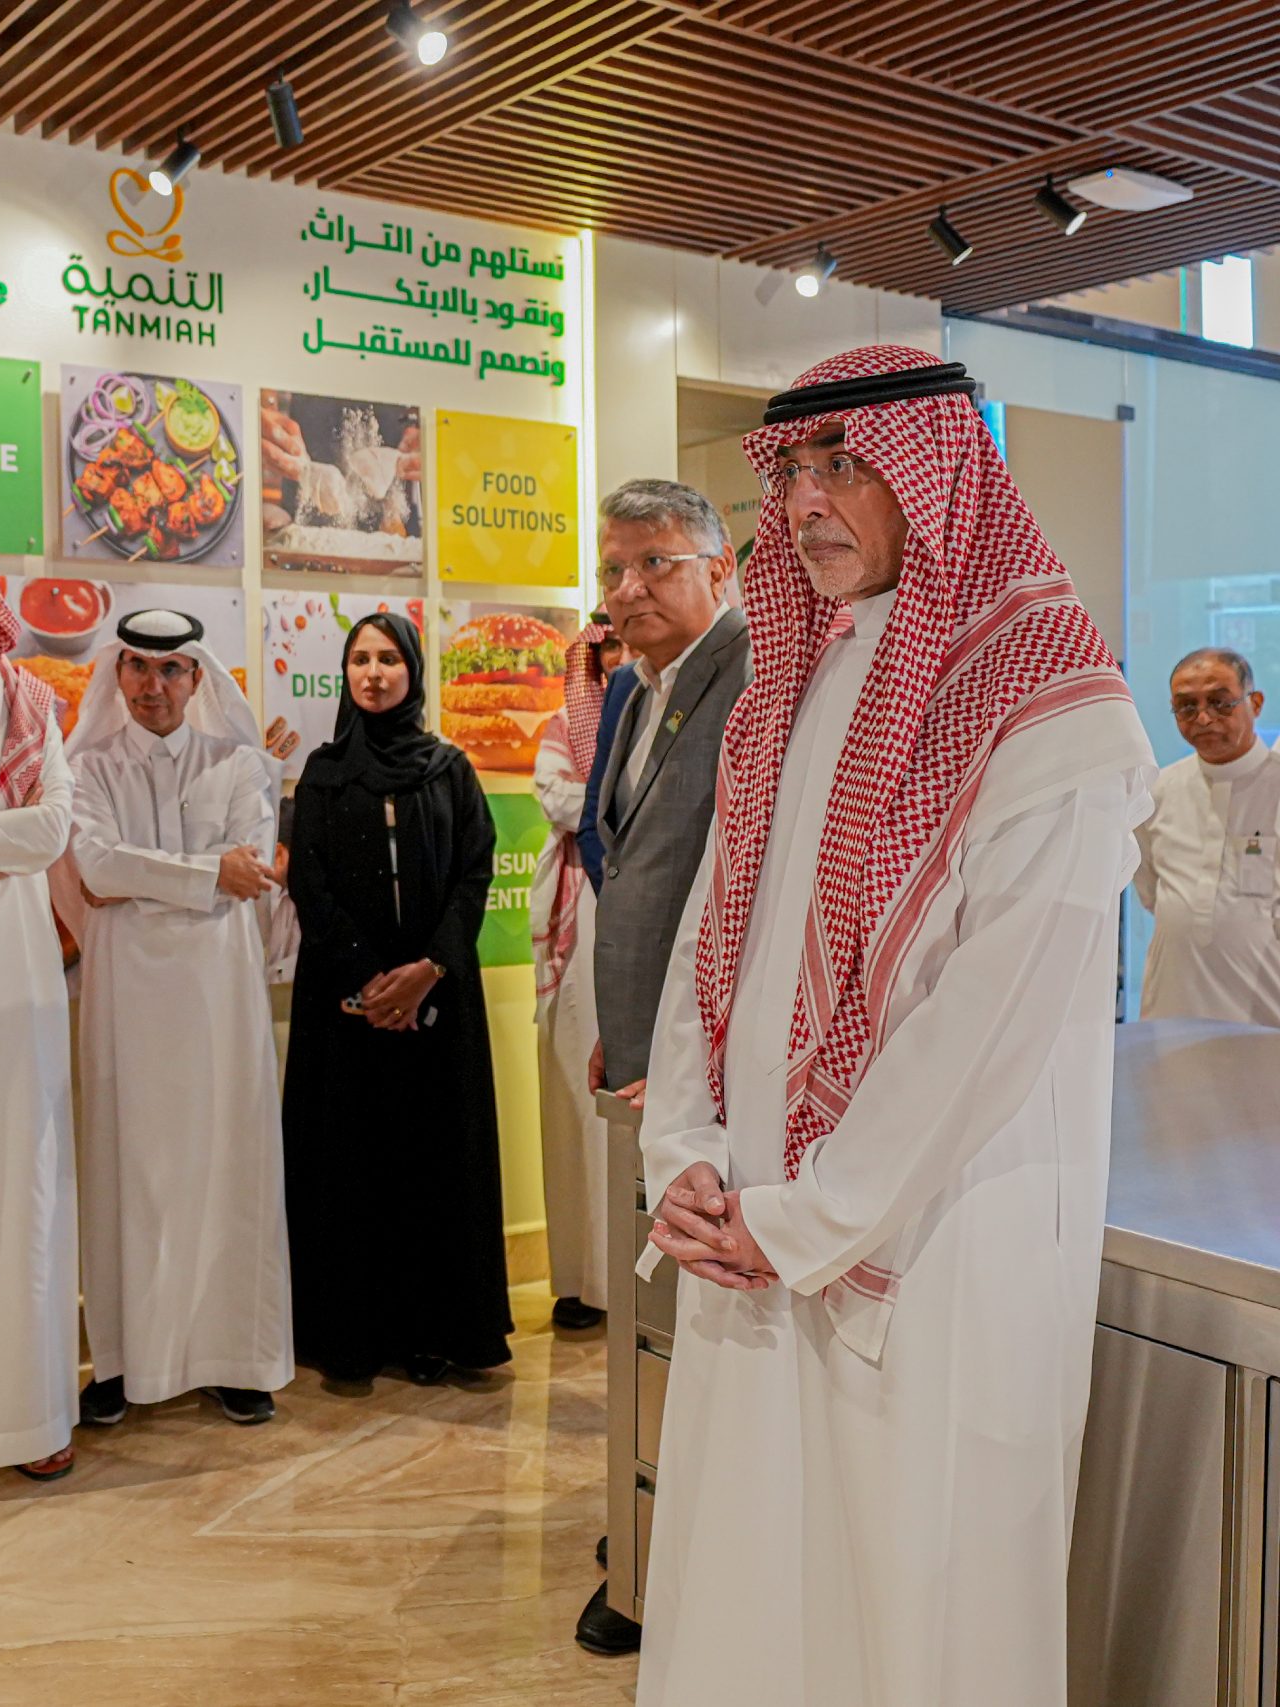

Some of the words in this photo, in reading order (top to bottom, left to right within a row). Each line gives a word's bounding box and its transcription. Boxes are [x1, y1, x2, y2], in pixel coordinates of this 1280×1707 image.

[422, 232, 461, 268] من
[469, 246, 564, 281] نستلهم
[63, 254, 223, 314] التنمية
[73, 305, 215, 347] TANMIAH
[485, 298, 564, 337] ونقود
[303, 318, 471, 365] للمستقبل
[480, 349, 565, 387] ونصمم
[482, 471, 537, 497] FOOD
[452, 504, 567, 534] SOLUTIONS
